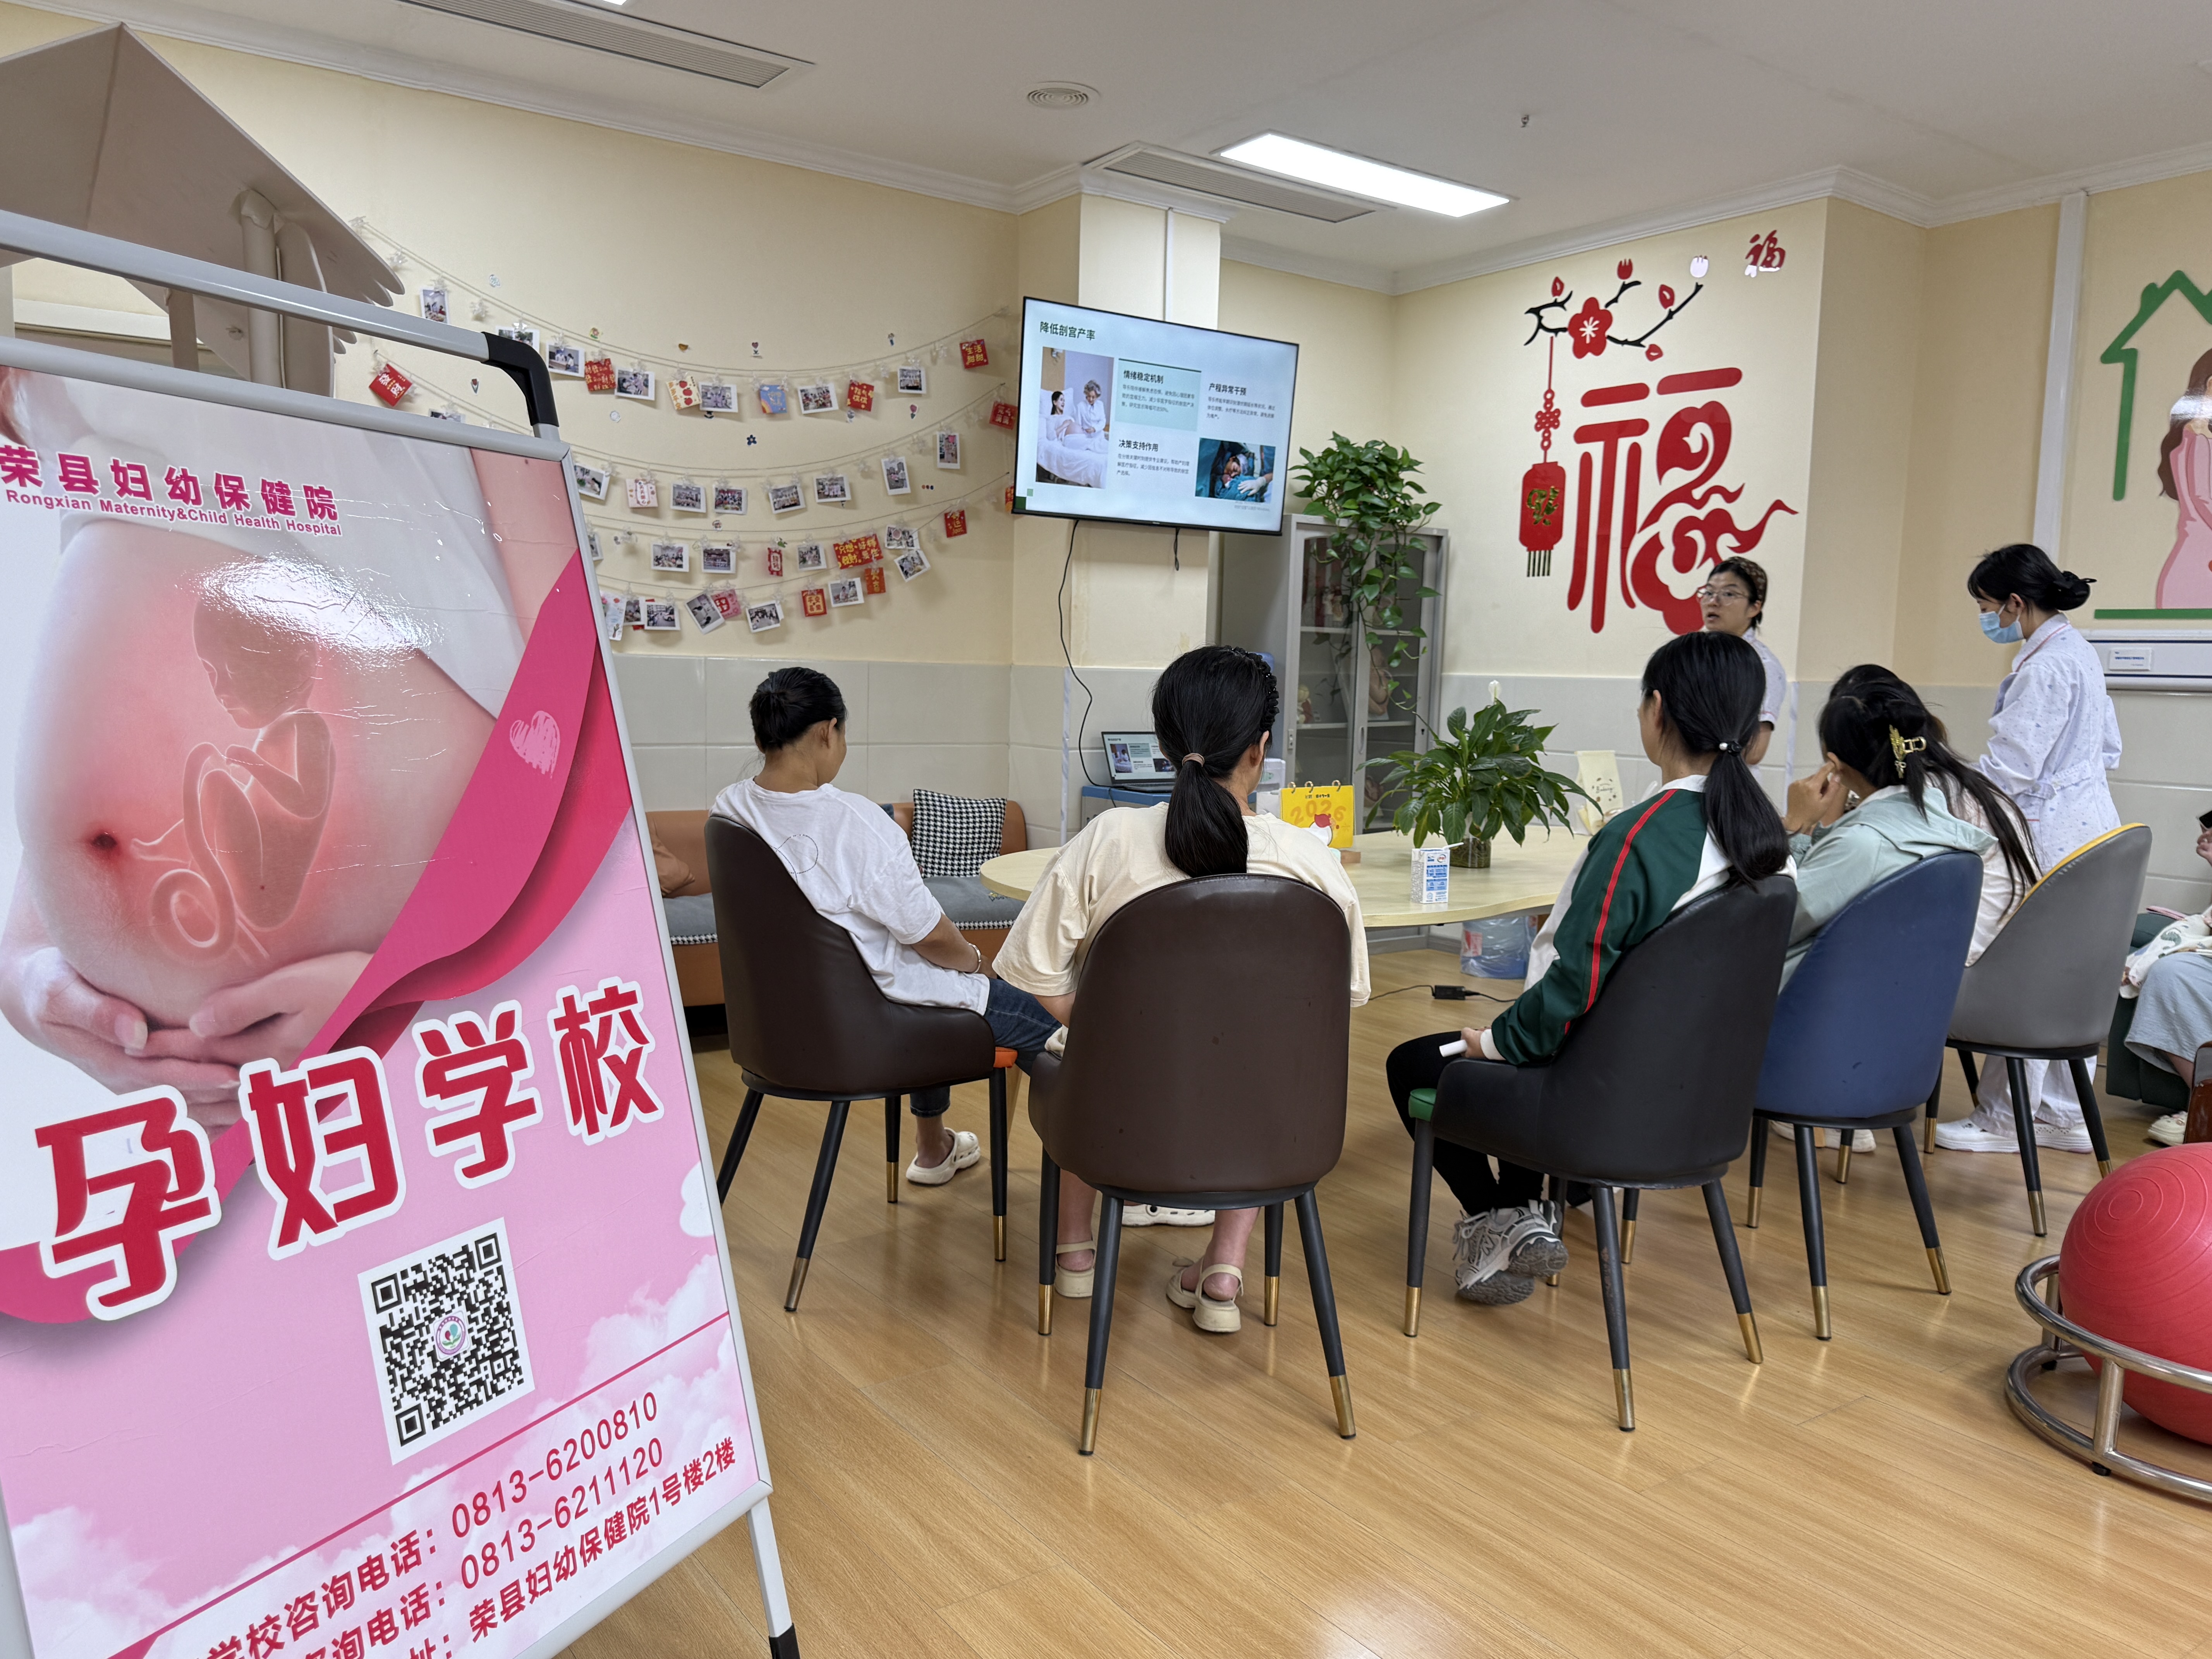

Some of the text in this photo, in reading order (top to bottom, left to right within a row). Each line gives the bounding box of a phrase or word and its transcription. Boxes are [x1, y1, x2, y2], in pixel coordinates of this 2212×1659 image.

[1744, 229, 1786, 278] 福
[1040, 321, 1096, 341] 降低剖宫产率
[1123, 369, 1164, 384] 情绪稳定机制
[1208, 383, 1247, 396] 产程异常干预
[1118, 439, 1159, 452] 决策支持作用
[0, 445, 338, 521] 荣县妇幼保健院
[1567, 367, 1799, 635] 福
[6, 489, 342, 536] Rongxian Maternity&Child Health Hospital
[1290, 799, 1346, 826] 2026
[35, 986, 659, 1307] 孕妇学校
